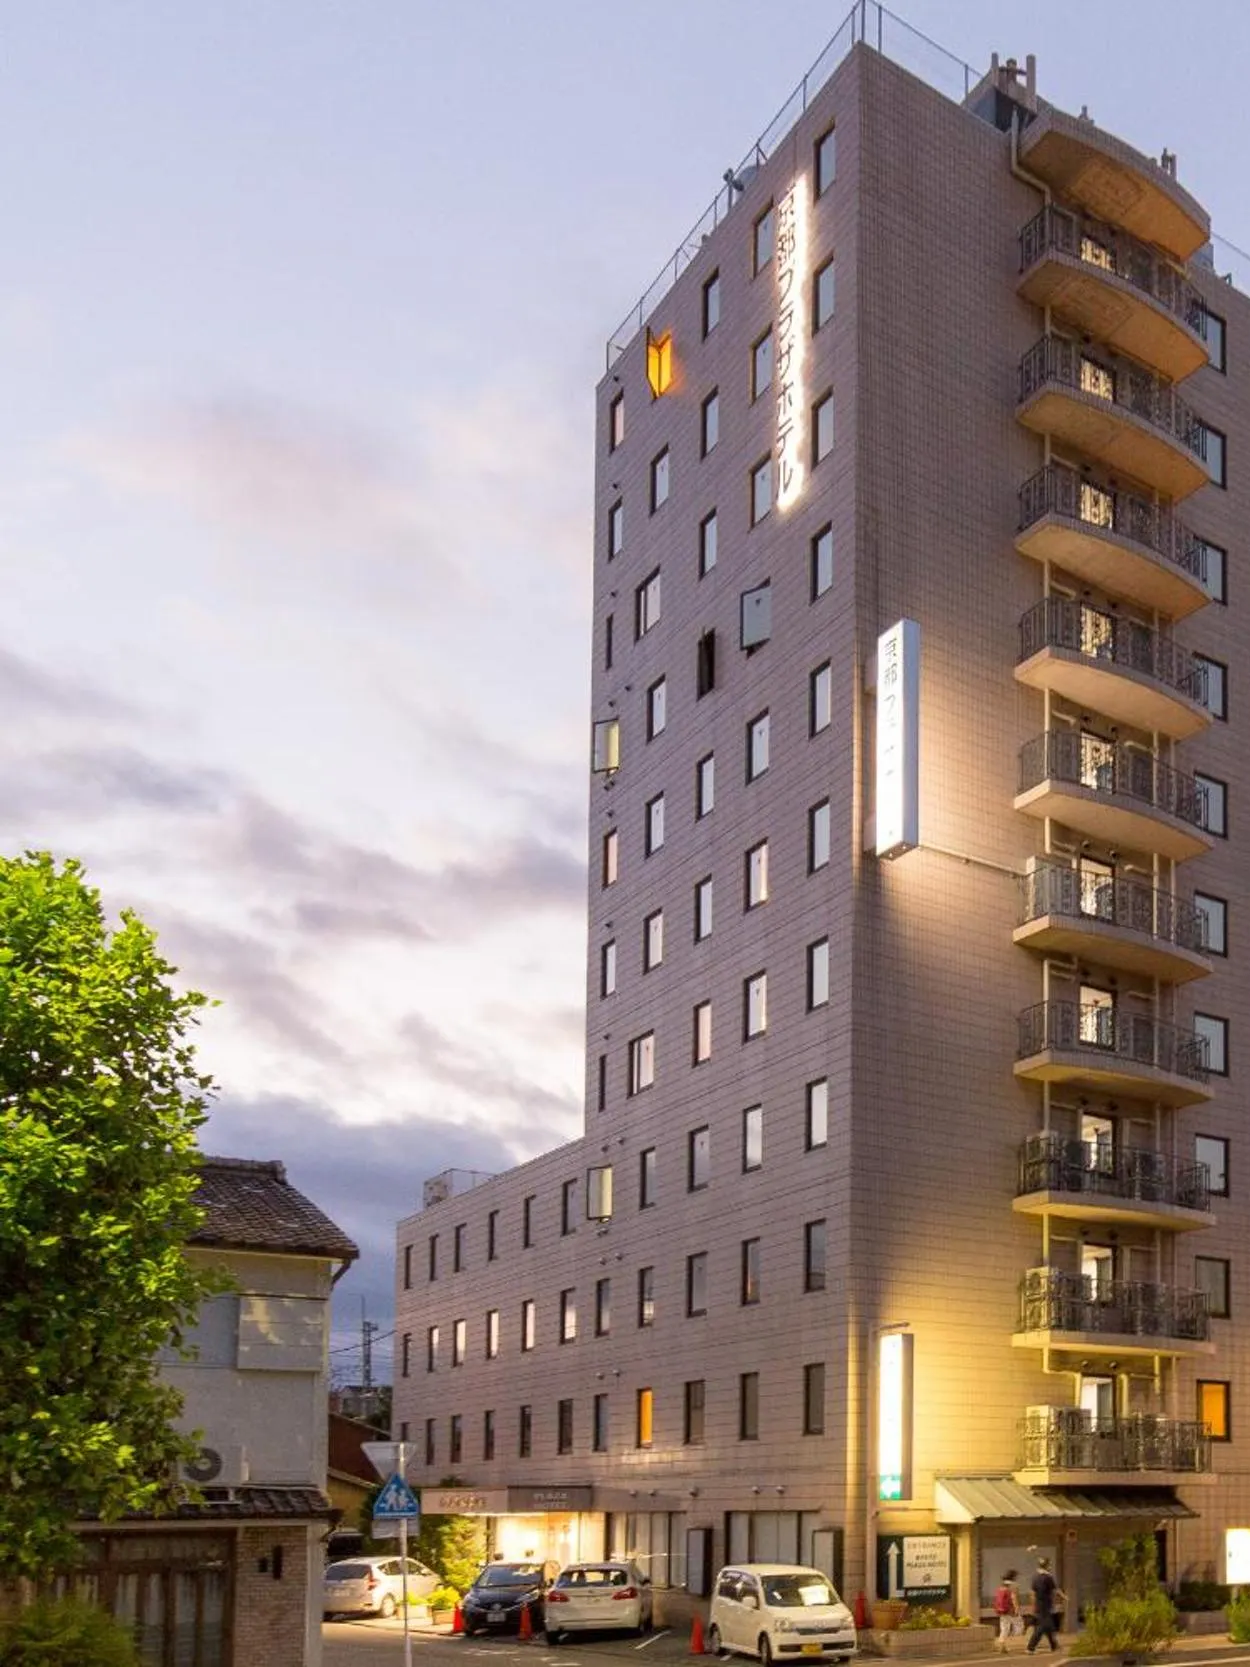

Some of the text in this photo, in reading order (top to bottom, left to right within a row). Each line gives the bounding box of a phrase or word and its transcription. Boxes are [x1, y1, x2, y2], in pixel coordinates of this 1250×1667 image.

[777, 183, 796, 494] 京都プラザホテル
